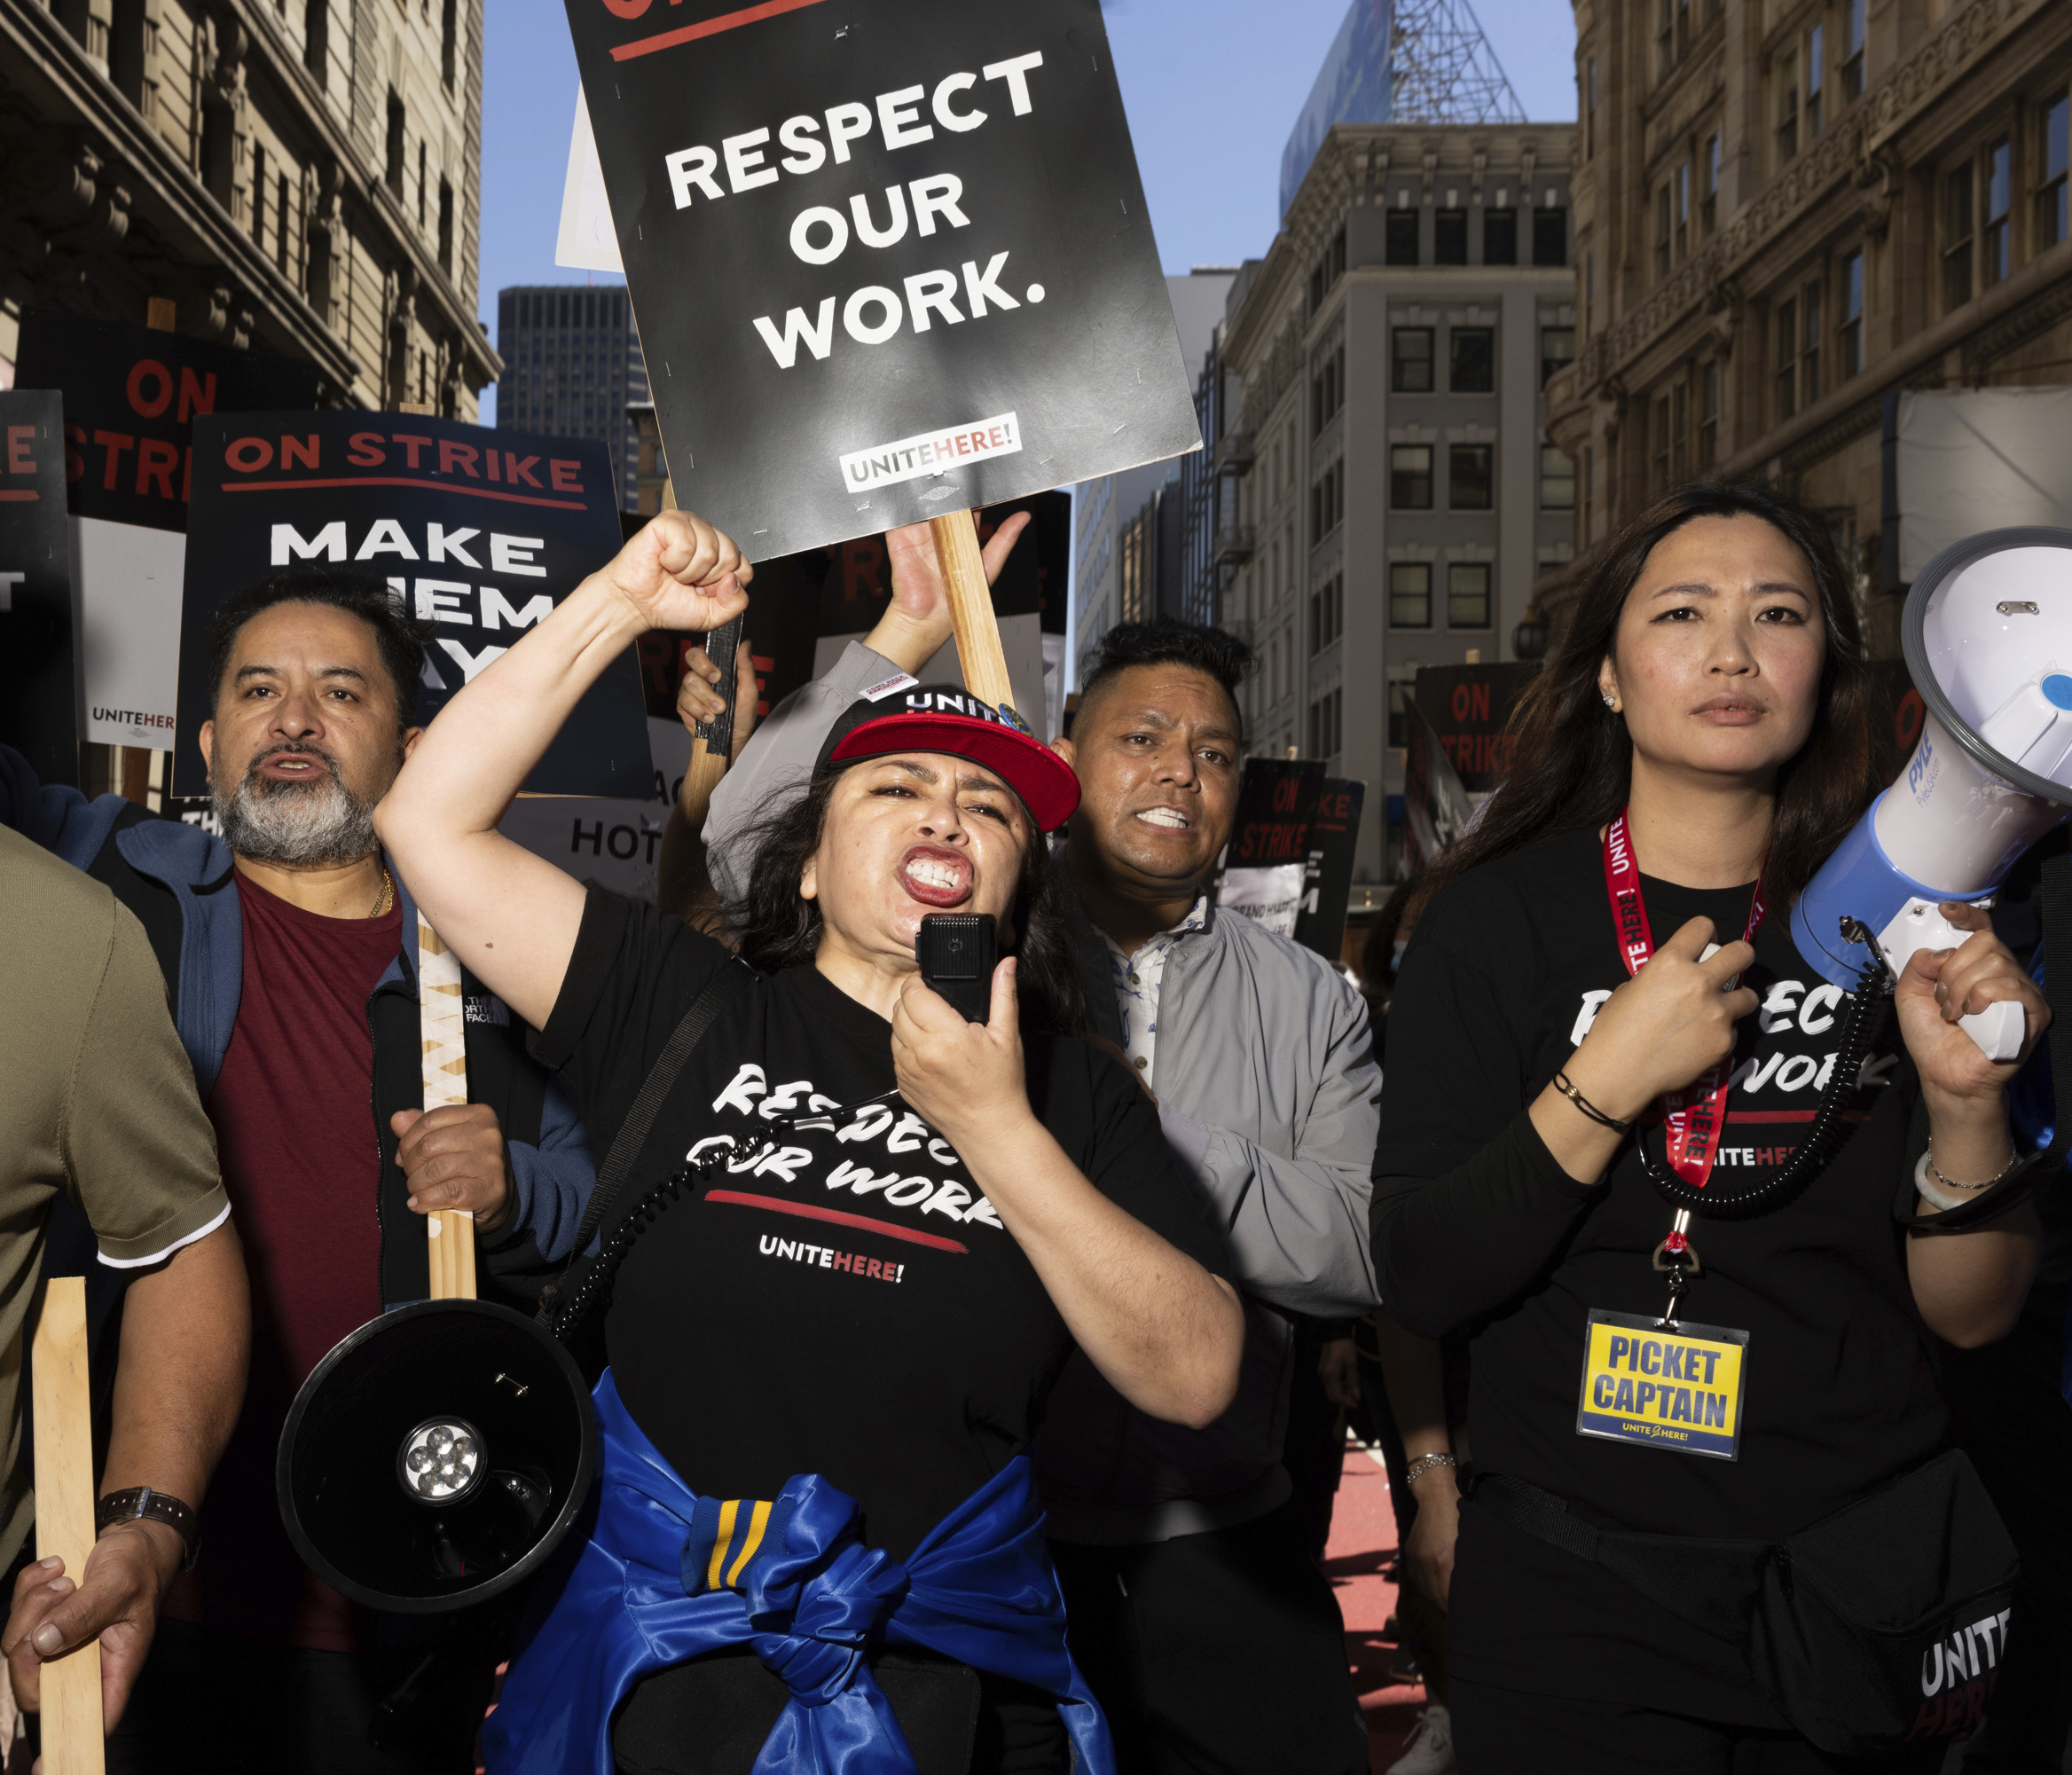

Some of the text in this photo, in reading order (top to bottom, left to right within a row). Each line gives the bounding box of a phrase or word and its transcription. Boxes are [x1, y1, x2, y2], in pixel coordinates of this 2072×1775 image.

[665, 51, 1043, 209] RESPECT
[789, 173, 970, 264] OUR
[753, 251, 1045, 369] WORK.
[127, 359, 216, 423] ON
[225, 432, 585, 493] ON STRIKE
[849, 423, 1013, 483] UNITEHERE!
[271, 519, 547, 577] MAKE
[1451, 682, 1491, 723] ON
[1273, 777, 1300, 813] ON
[1239, 822, 1307, 859] STRIKE
[1609, 817, 1648, 975] TEHERE! UNITE
[759, 1235, 905, 1284] UNITEHERE!
[1608, 1335, 1722, 1386] PICKET
[1593, 1374, 1728, 1429] CAPTAIN
[1622, 1422, 1689, 1441] UNITE HERE!
